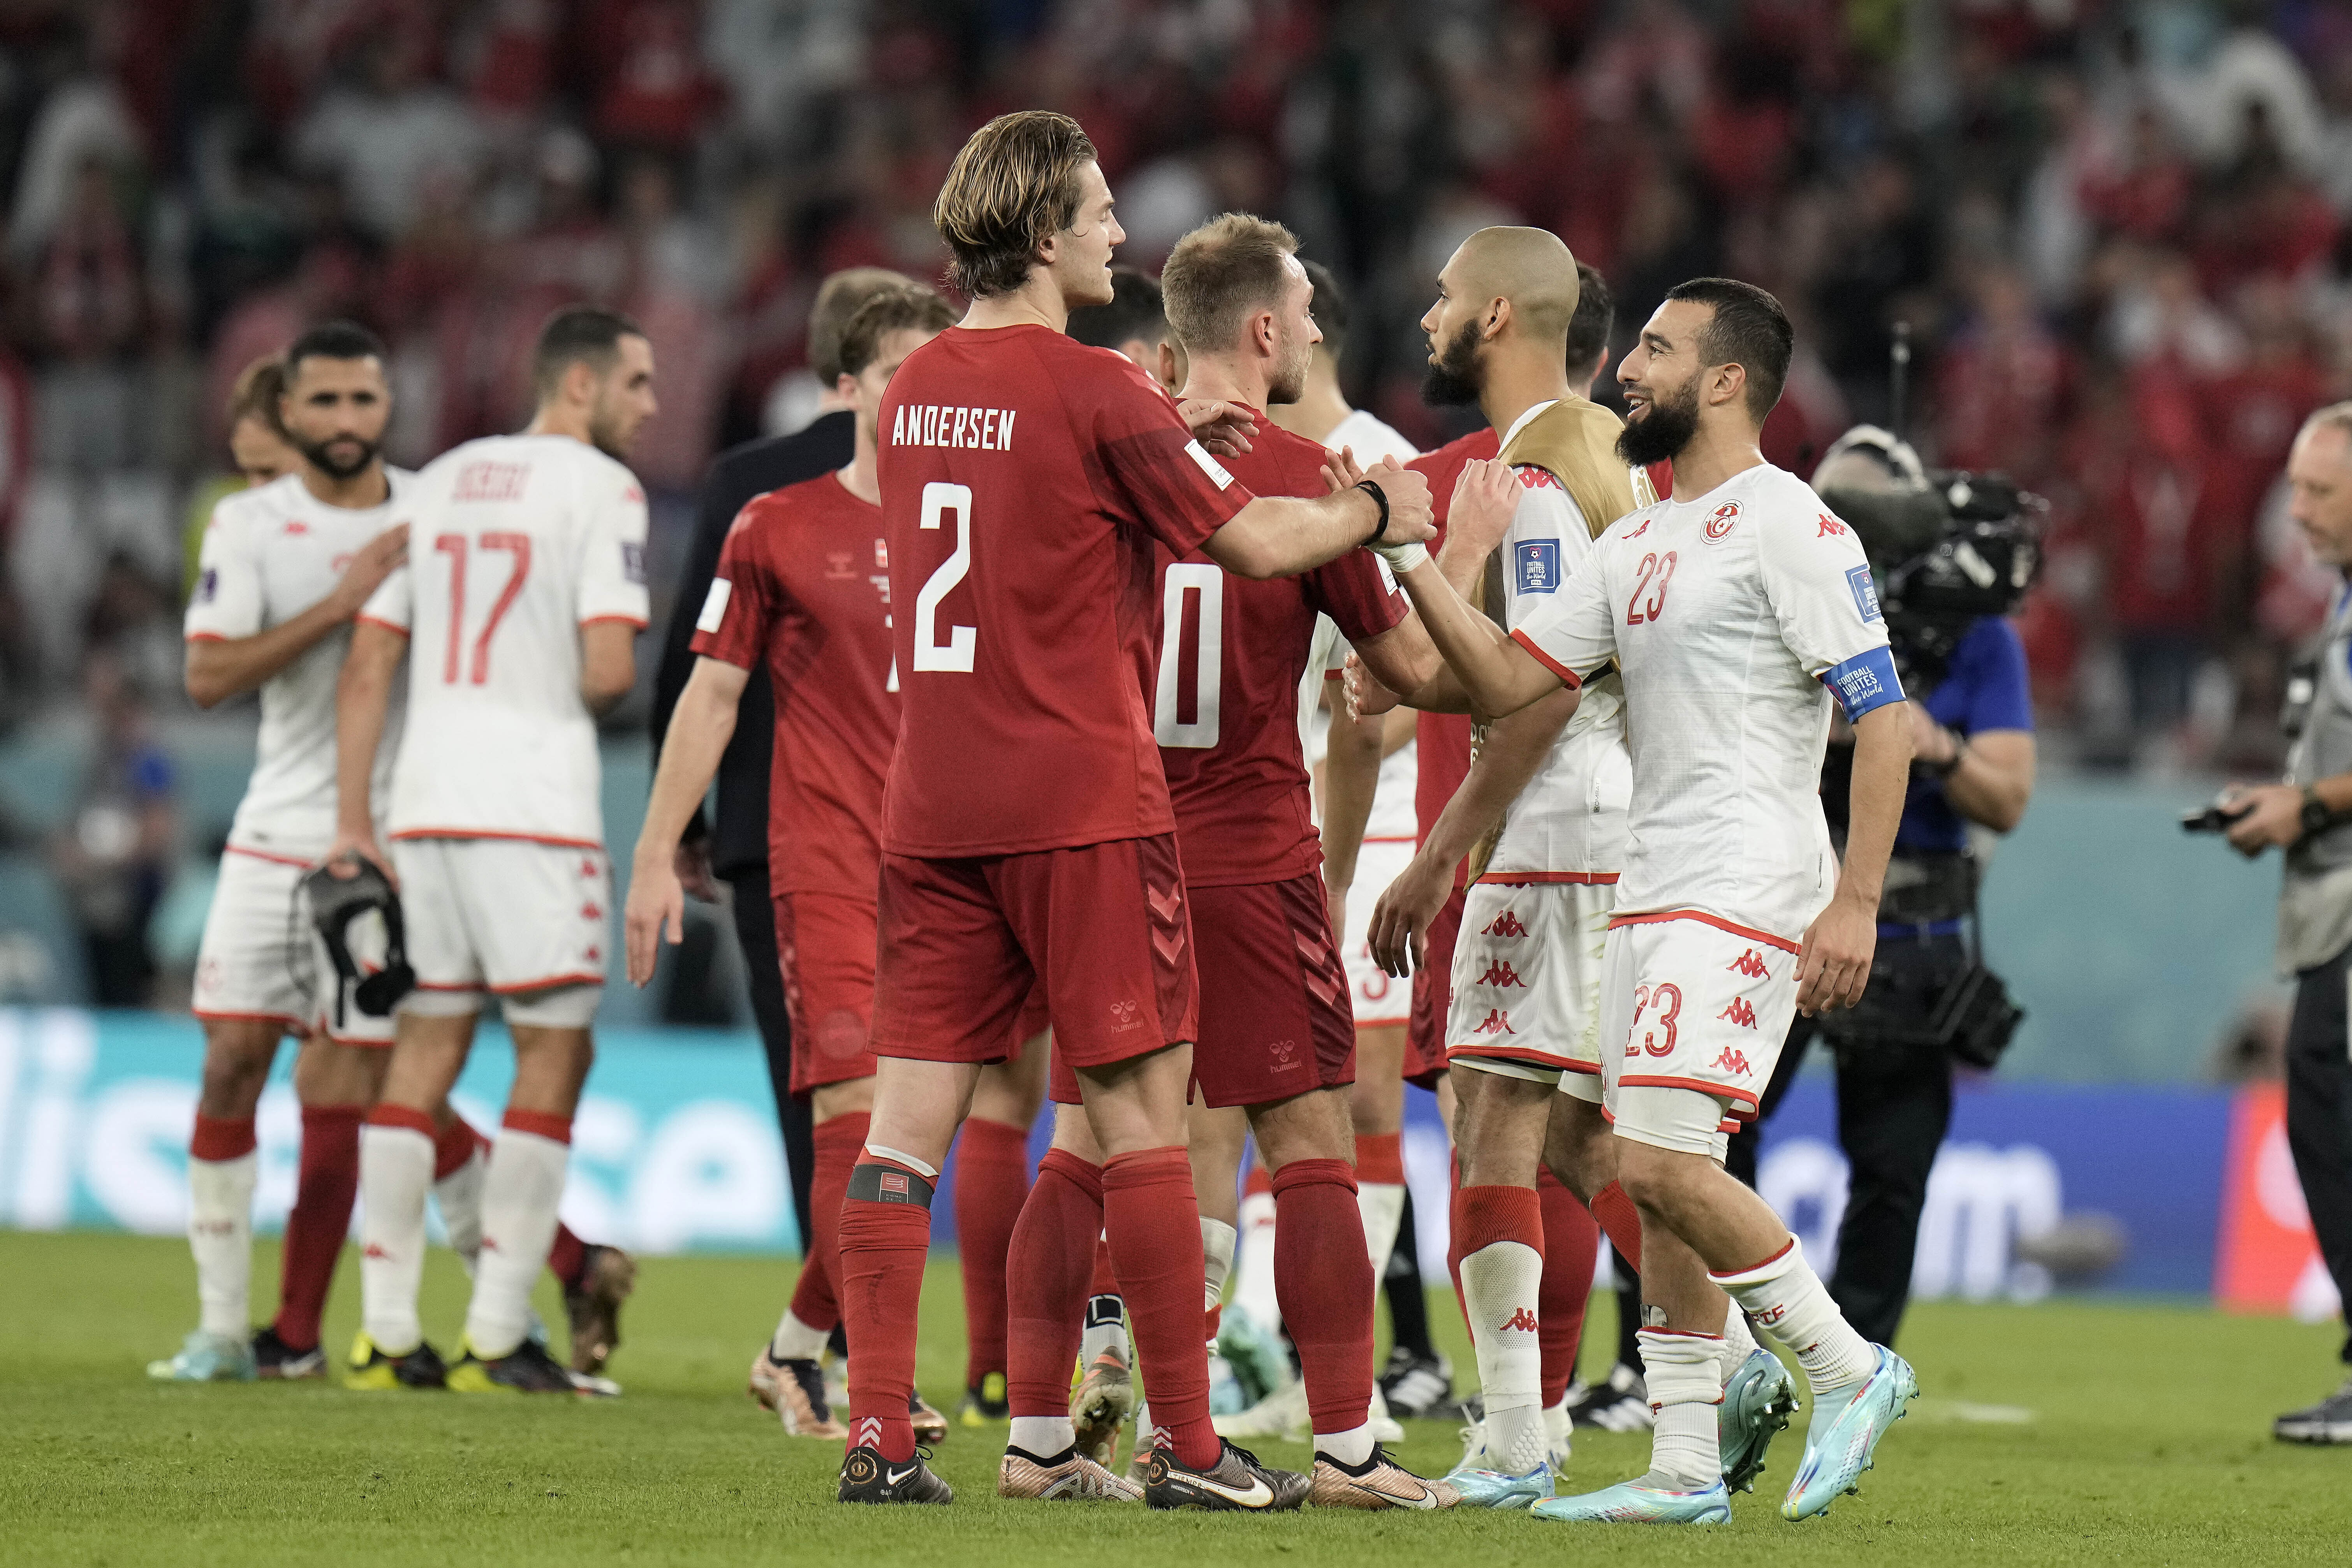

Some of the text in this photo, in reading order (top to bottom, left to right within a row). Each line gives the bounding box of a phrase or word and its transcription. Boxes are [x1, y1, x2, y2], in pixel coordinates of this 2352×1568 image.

[892, 405, 1016, 451] ANDERSEN
[913, 482, 977, 673] 2
[1627, 551, 1677, 625] 23
[435, 530, 531, 685] 17
[1837, 665, 1872, 687] FOOTBALL
[1842, 673, 1878, 696] UNITES
[1850, 683, 1884, 706] the World
[1111, 1019, 1144, 1034] hummel
[1625, 983, 1682, 1057] 23
[1270, 1058, 1302, 1073] hummel
[1171, 1484, 1190, 1494] ANDERSEN
